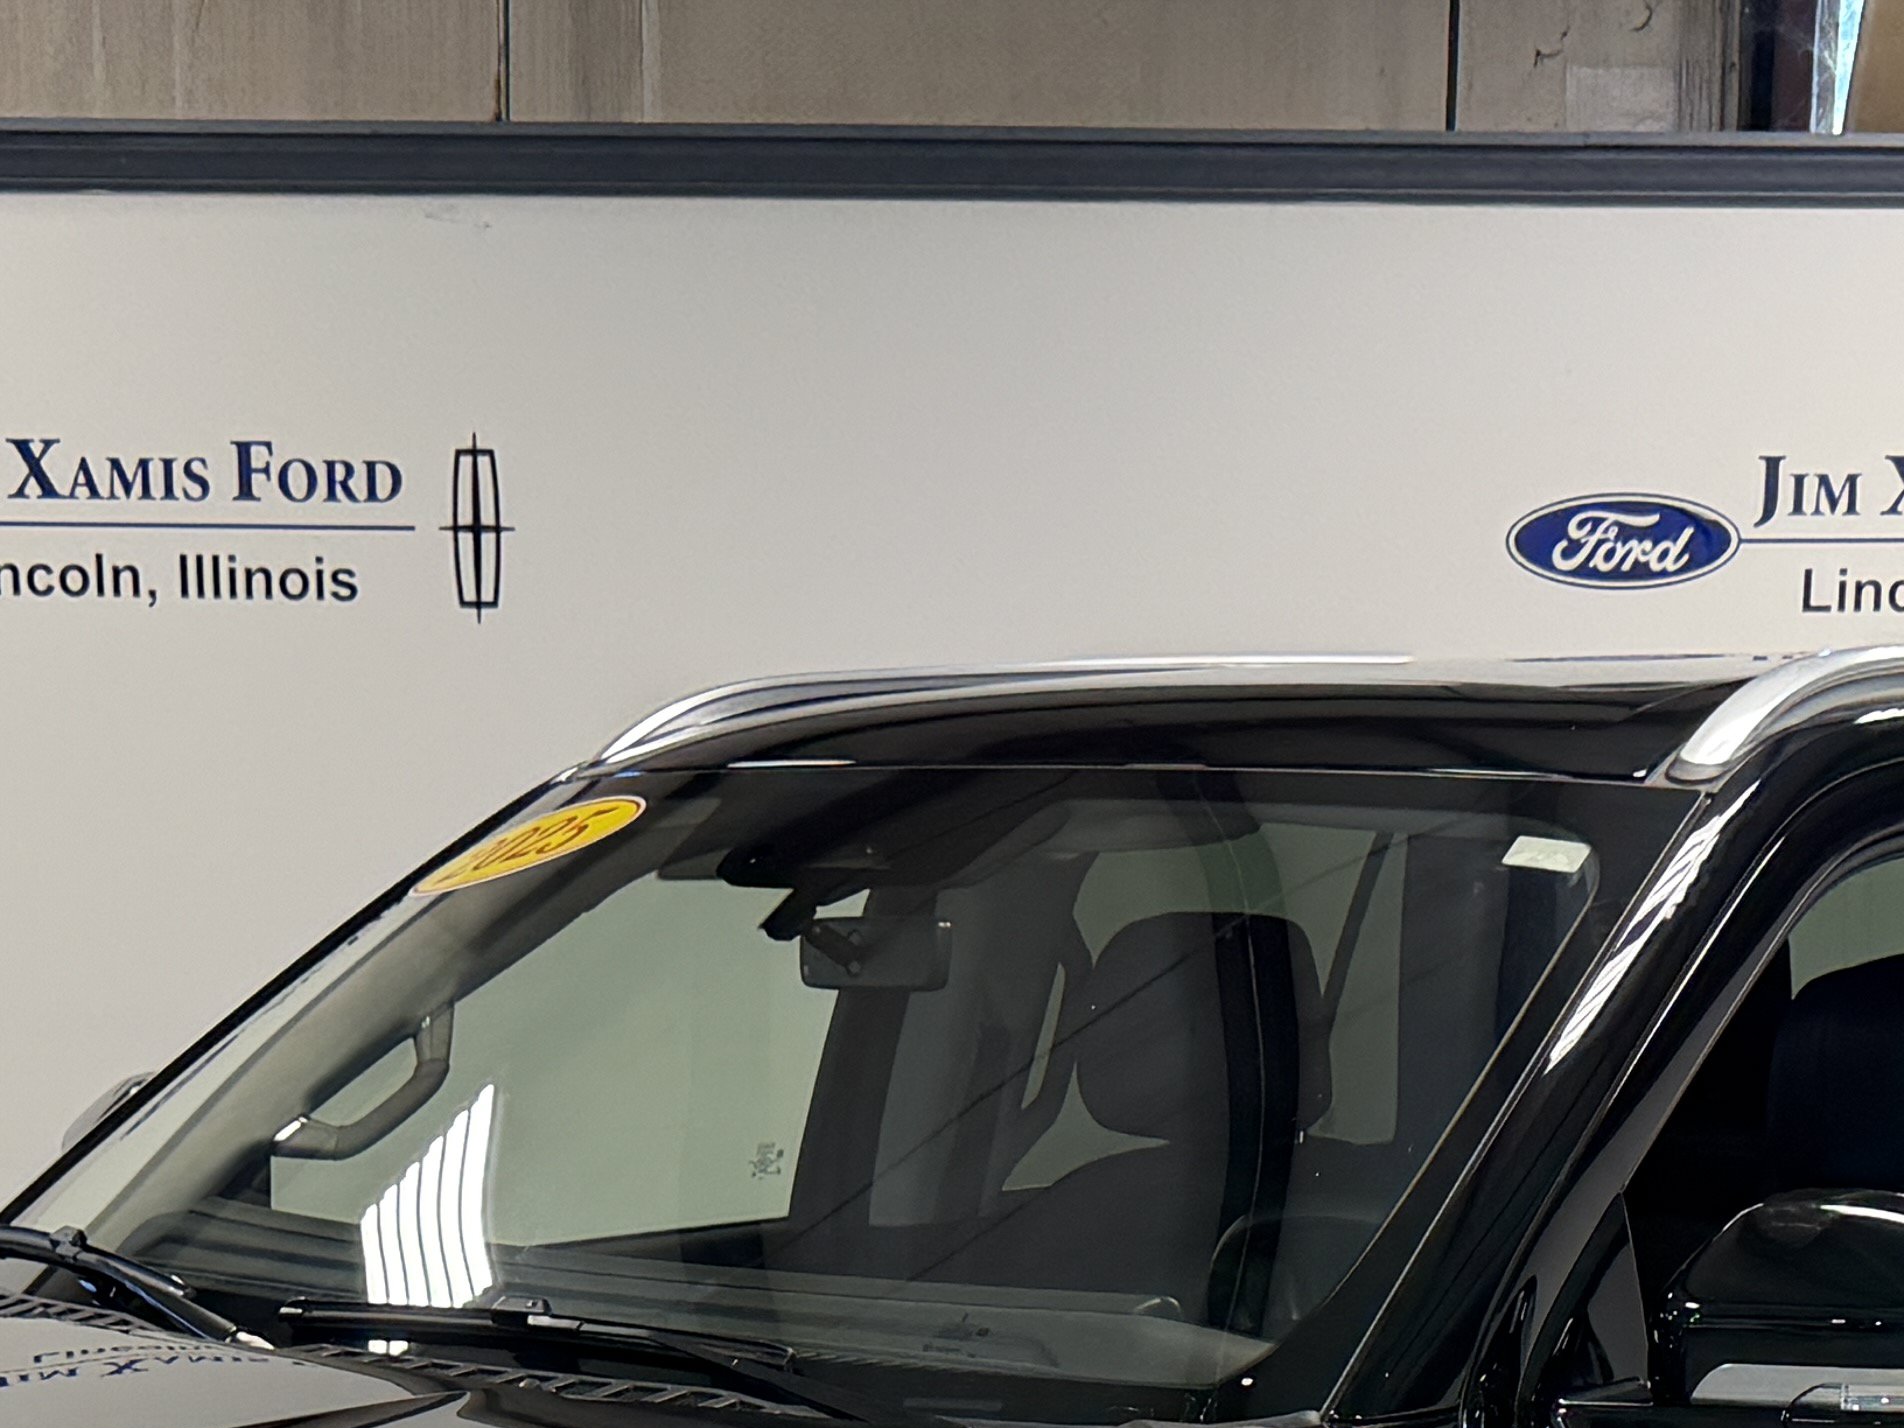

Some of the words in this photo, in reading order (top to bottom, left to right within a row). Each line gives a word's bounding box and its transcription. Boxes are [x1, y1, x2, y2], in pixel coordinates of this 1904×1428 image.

[5, 437, 211, 503] XAMIS
[230, 440, 403, 503] FORD
[1753, 455, 1862, 528] JIM
[1550, 508, 1693, 575] Ford
[178, 553, 359, 602] Illinois
[431, 805, 620, 887] 2025
